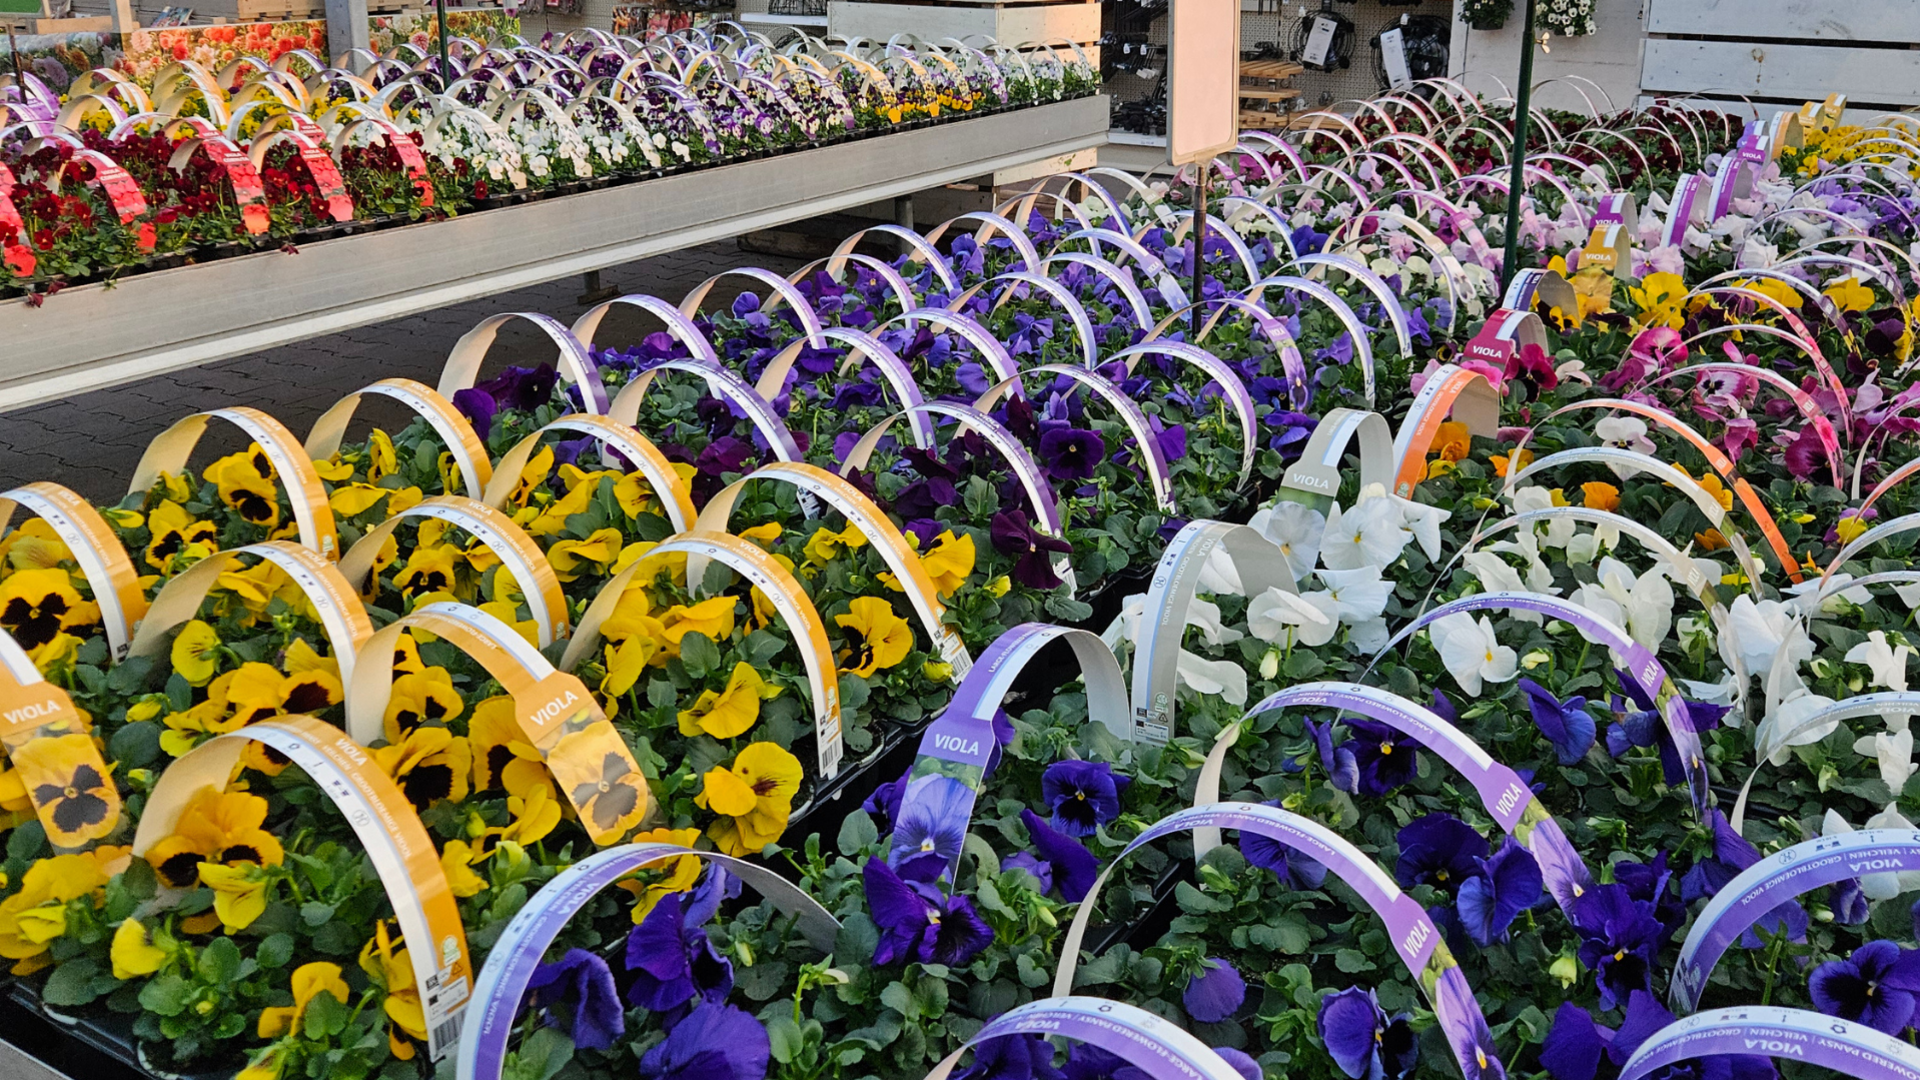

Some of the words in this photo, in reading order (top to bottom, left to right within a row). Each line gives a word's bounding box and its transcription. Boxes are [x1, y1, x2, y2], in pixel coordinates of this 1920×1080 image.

[1586, 253, 1611, 261] VIOLA
[1472, 345, 1502, 359] VIOLA
[612, 421, 635, 438] VIOLA
[1292, 473, 1329, 490] VIOLA
[840, 482, 864, 502] VIOLA
[468, 501, 493, 516] VIOLA
[302, 550, 328, 568] VIOLA
[739, 541, 768, 562] VIOLA
[1641, 660, 1660, 688] VIOLA
[1338, 693, 1363, 702] PANSY
[3, 699, 62, 725] VIOLA
[530, 690, 579, 727] VIOLA
[1364, 699, 1434, 735] LARGE-FLOWERED
[335, 738, 368, 767] VIOLA
[935, 733, 979, 756] VIOLA
[351, 772, 399, 833] GROOTBLOEMIGE
[1495, 782, 1523, 818] VIOLA
[1174, 818, 1214, 830] VIOLA
[1227, 812, 1257, 822] PANSY
[1257, 818, 1337, 856] LARGE-FLOWERED
[1849, 848, 1901, 860] VEILCHEN
[1763, 855, 1842, 892] GROOTBLOEMIGE
[1848, 858, 1904, 873] VIOLA
[557, 881, 600, 917] VIOLA
[1741, 887, 1765, 906] VIOOL
[1402, 919, 1432, 959] VIOLA
[1015, 1019, 1060, 1031] VIOLA
[1750, 1028, 1808, 1042] VEILCHEN
[1745, 1039, 1803, 1057] VIOLA
[1818, 1038, 1858, 1057] PANSY
